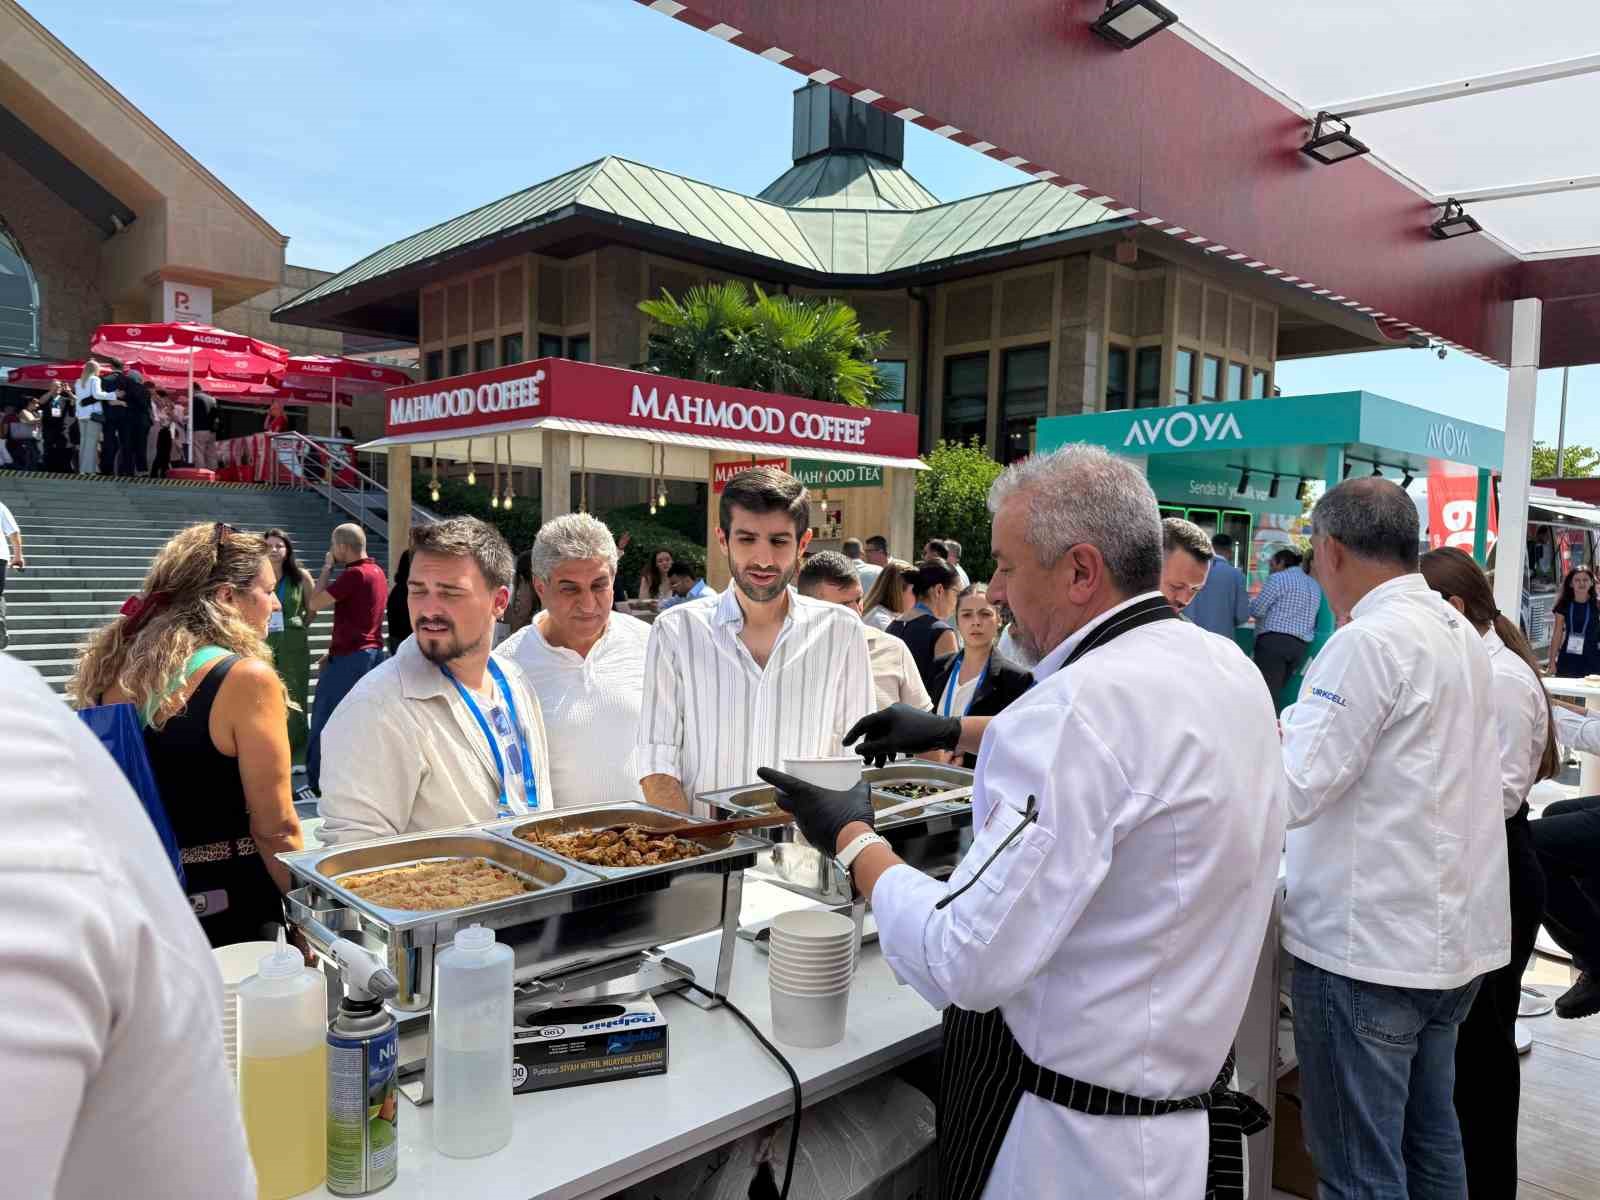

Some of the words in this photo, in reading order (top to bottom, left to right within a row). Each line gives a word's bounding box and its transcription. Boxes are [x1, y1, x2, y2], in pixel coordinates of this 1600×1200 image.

[193, 335, 227, 346] ALGIDA
[390, 388, 474, 425] MAHMOOD
[629, 384, 785, 434] MAHMOOD
[1123, 411, 1243, 447] AVOYA
[1425, 422, 1471, 457] AVOYA
